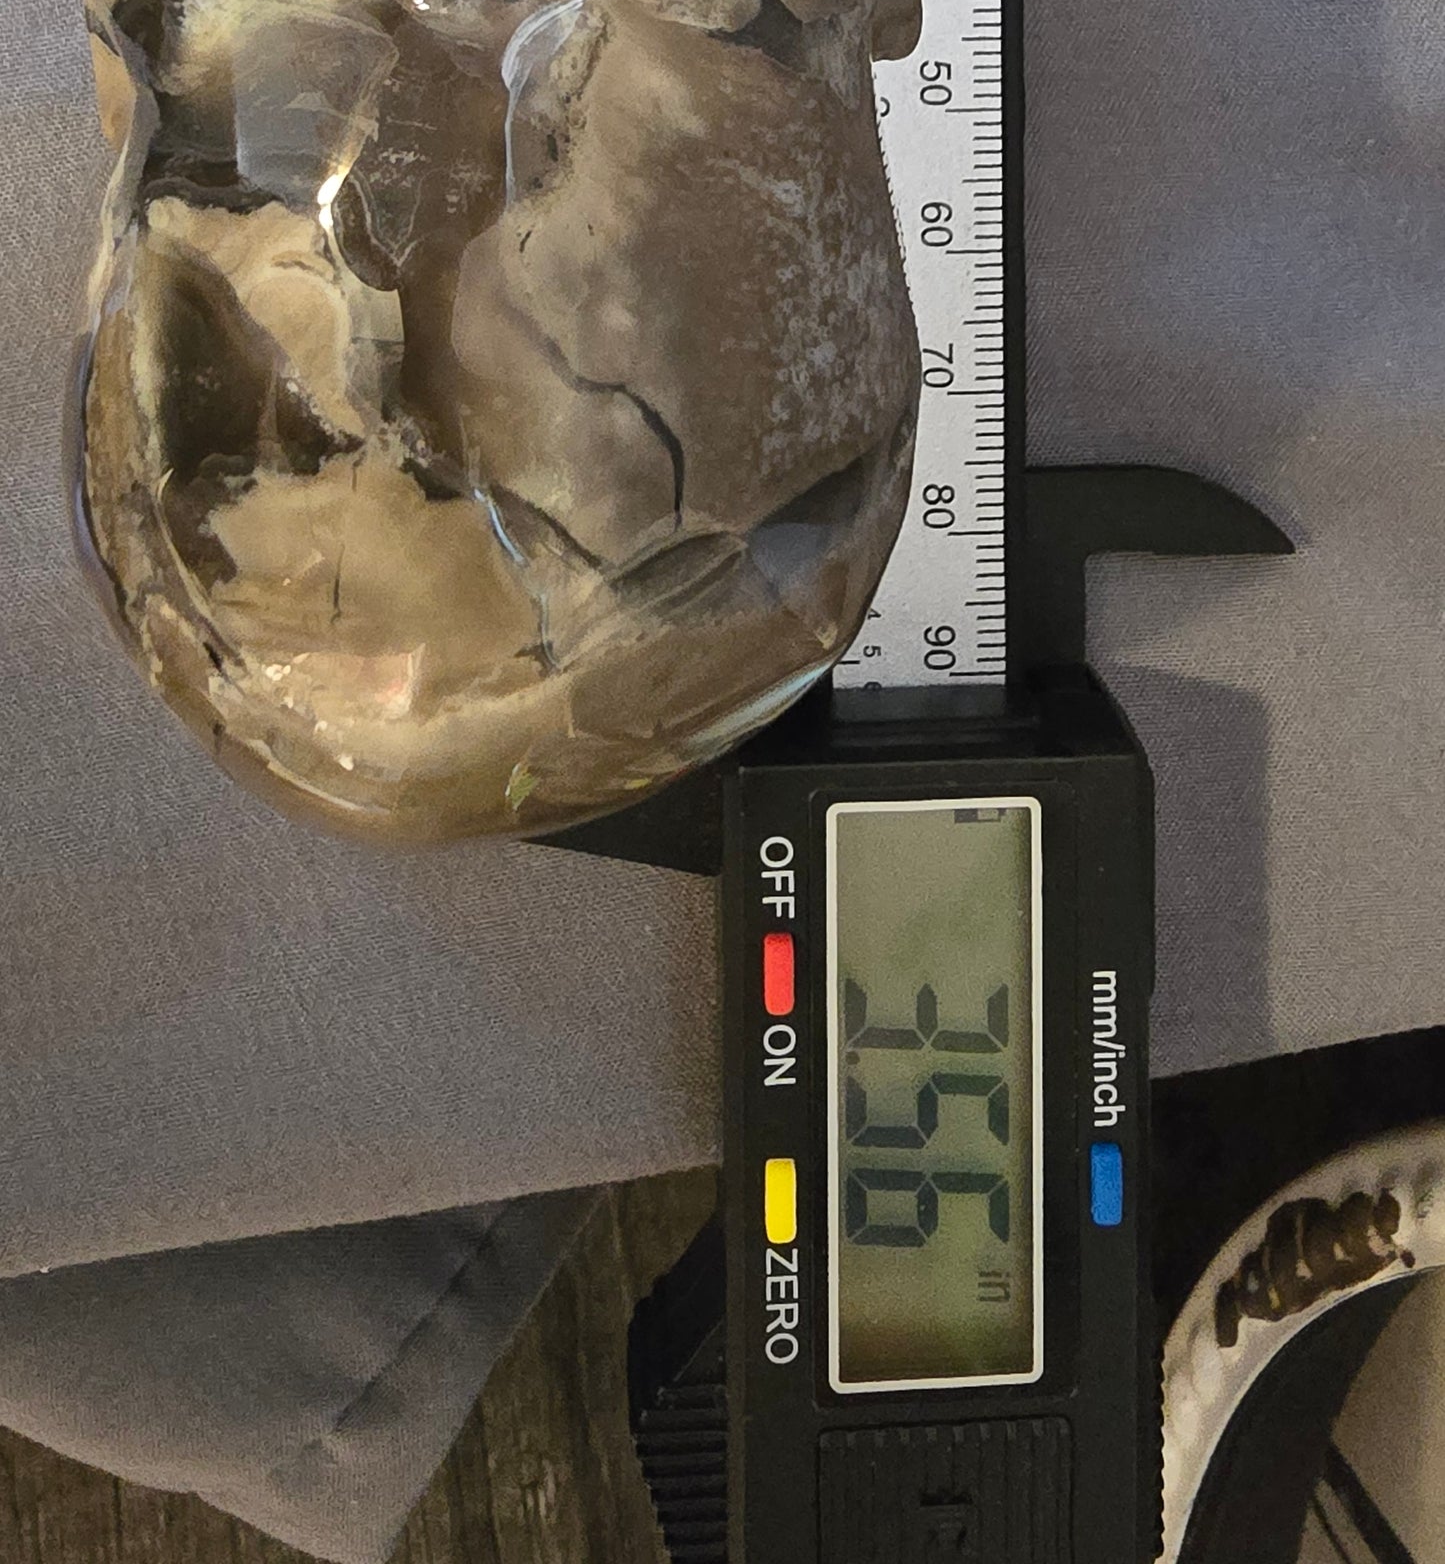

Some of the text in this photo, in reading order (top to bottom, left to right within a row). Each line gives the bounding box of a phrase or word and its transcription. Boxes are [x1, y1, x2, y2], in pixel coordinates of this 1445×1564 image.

[919, 60, 953, 106] 50
[920, 201, 954, 248] 60
[922, 343, 955, 389] 70
[922, 483, 956, 529] 80
[863, 645, 882, 658] 5
[923, 625, 957, 671] 90
[759, 836, 795, 919] OFF
[763, 1024, 797, 1087] ON
[1092, 970, 1126, 1127] mm/inch
[844, 978, 1012, 1303] 3.56 in
[765, 1248, 799, 1364] ZERO
